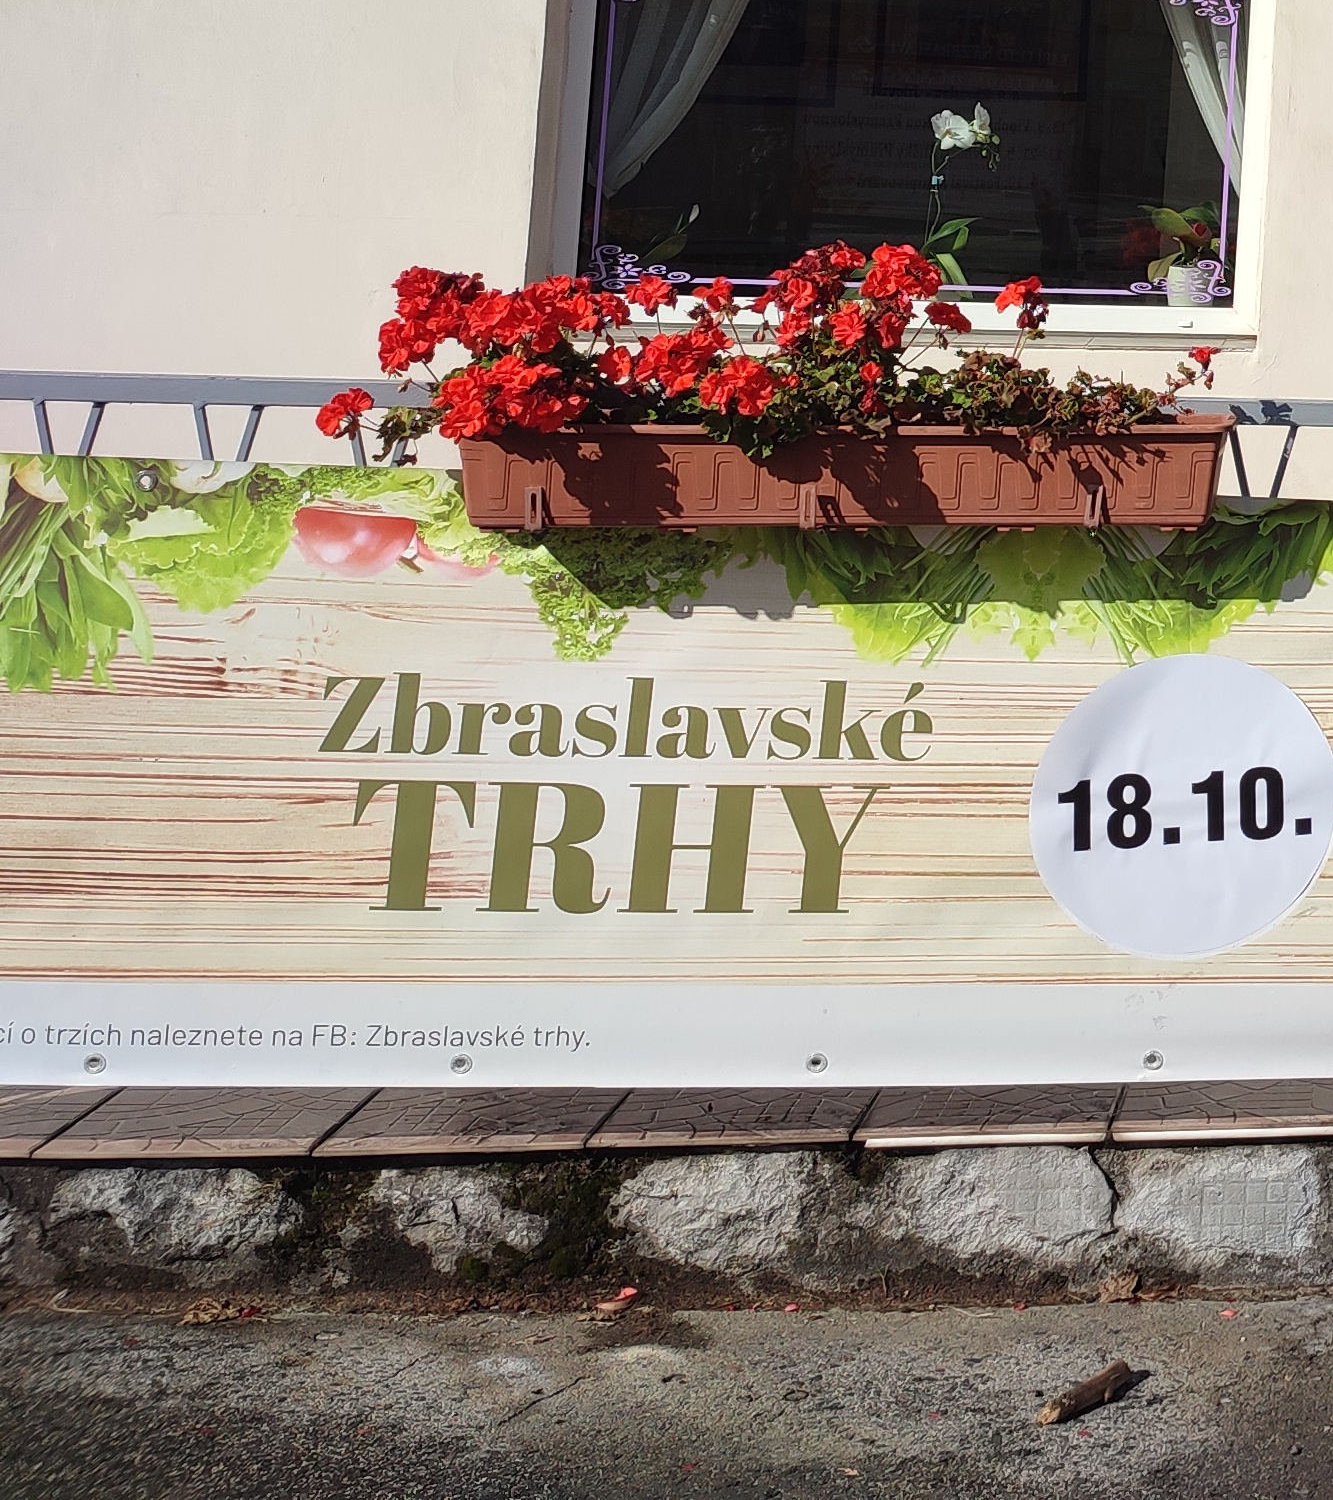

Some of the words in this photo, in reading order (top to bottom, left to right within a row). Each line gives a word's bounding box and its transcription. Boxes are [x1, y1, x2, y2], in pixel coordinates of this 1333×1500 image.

[318, 672, 934, 762] Zbraslavské
[353, 780, 892, 914] TRHY
[1057, 766, 1313, 852] 18.10.
[21, 1027, 37, 1045] o
[44, 1022, 122, 1046] trzích
[130, 1024, 263, 1048] naleznete
[271, 1030, 304, 1048] na
[311, 1024, 358, 1048] FB:
[365, 1024, 525, 1048] Zbraslavské
[532, 1026, 592, 1053] trhy.
